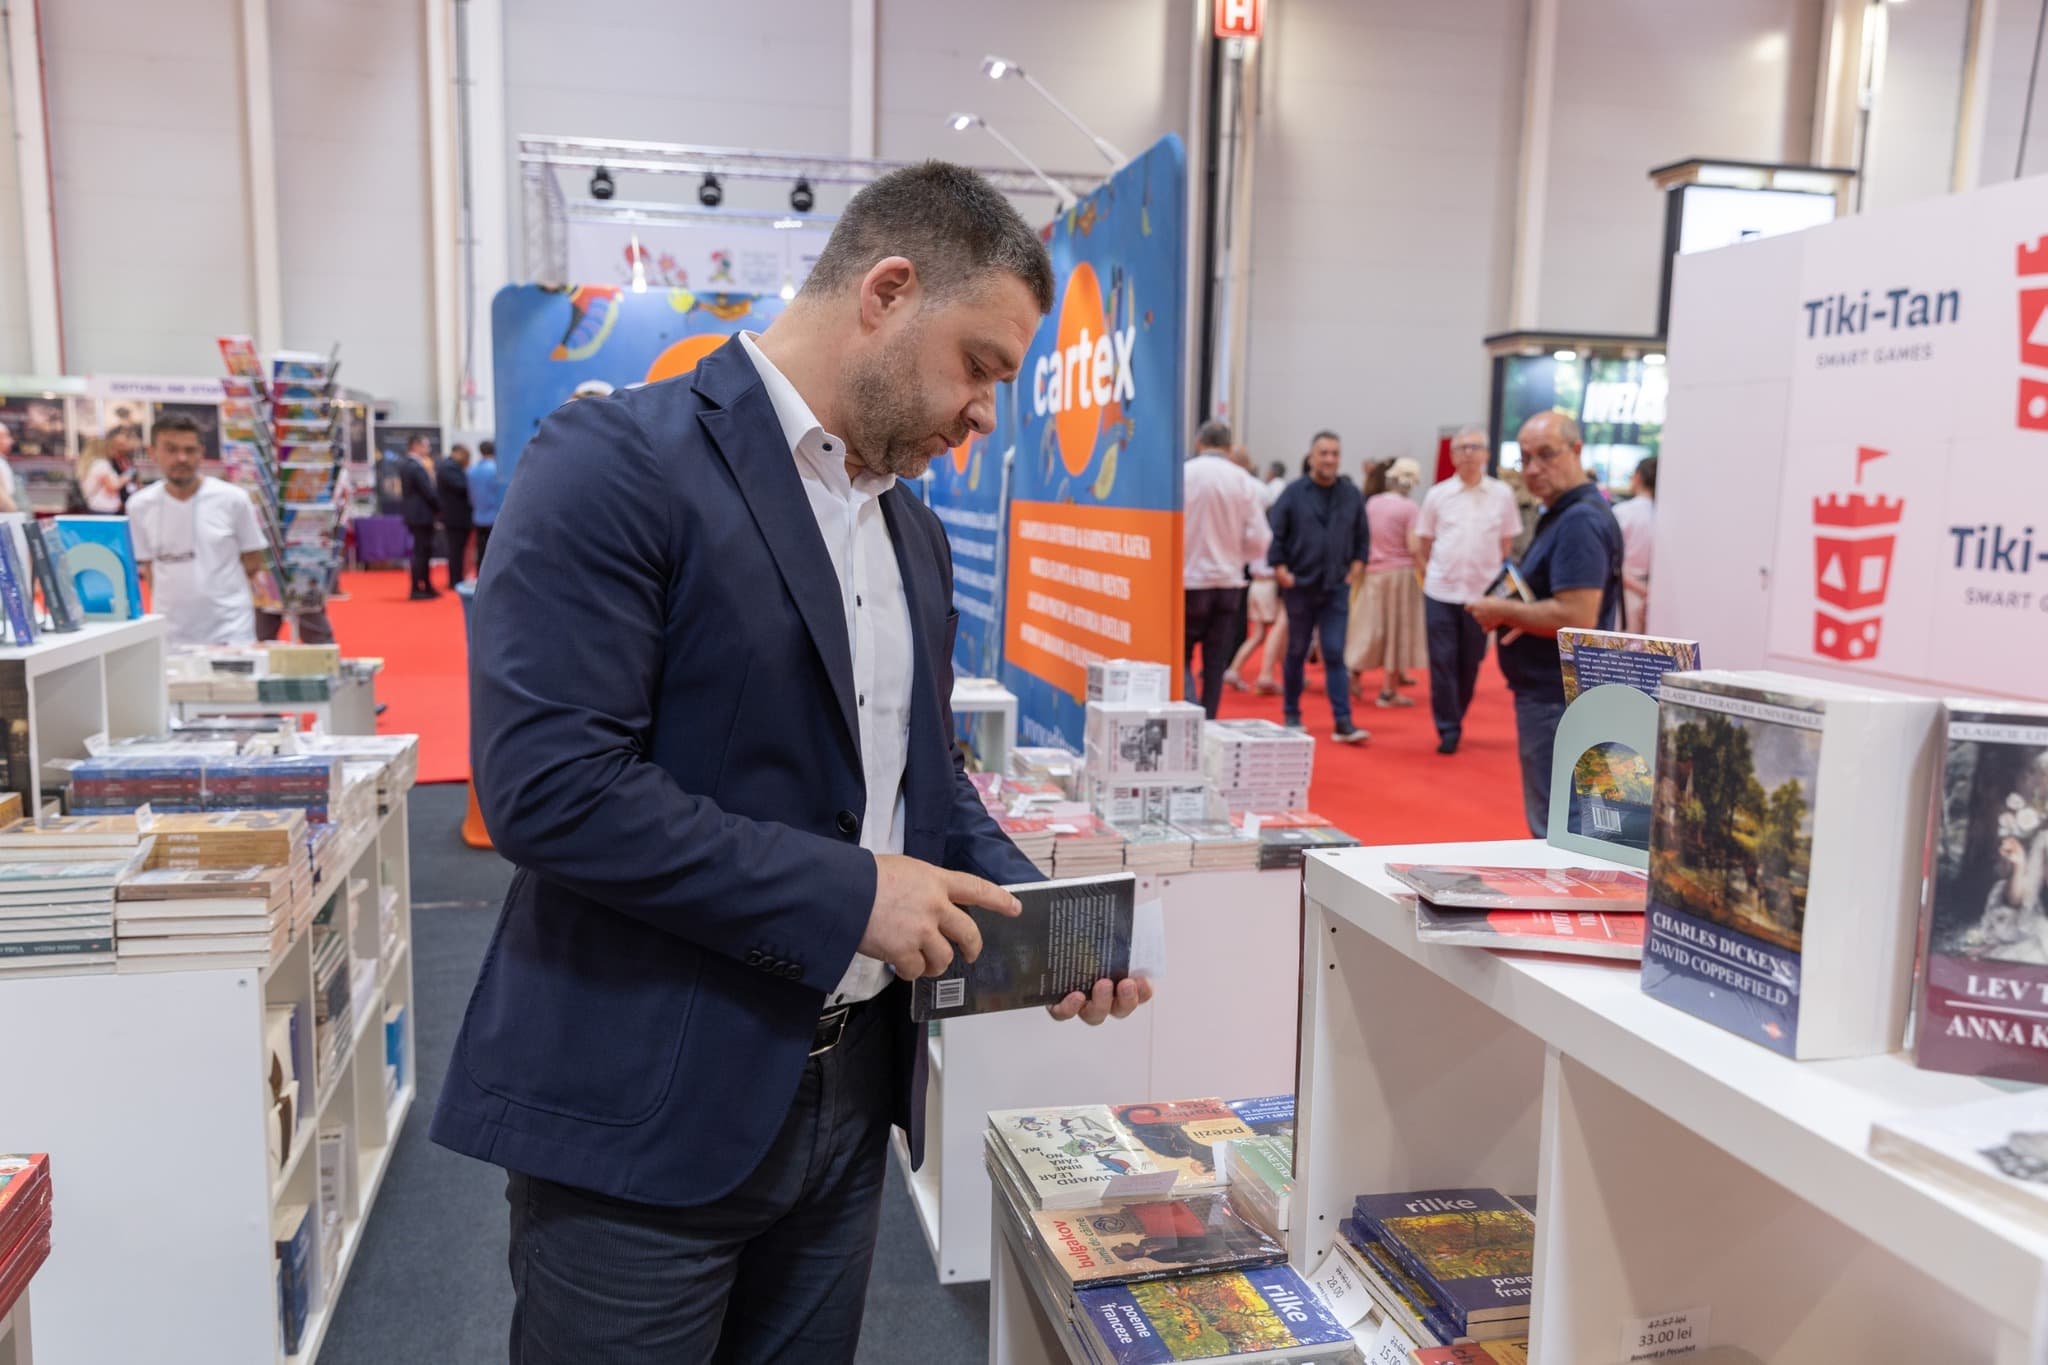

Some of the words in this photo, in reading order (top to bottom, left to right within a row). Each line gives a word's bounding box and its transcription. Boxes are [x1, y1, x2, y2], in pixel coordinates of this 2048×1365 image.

[1804, 287, 1961, 339] Tiki-Tan
[1816, 350, 1868, 369] SMART
[1873, 342, 1934, 364] GAMES
[1033, 325, 1136, 417] cartex
[1965, 587, 2032, 608] SMART
[1652, 911, 1717, 949] CHARLES
[1719, 937, 1793, 977] DICKENS
[1651, 938, 1690, 966] DAVID
[1691, 955, 1789, 1006] COPPERFIELD
[1967, 975, 2031, 1001] LEV
[1945, 1014, 2026, 1046] ANNA
[1193, 1125, 1245, 1139] poezii
[1038, 1172, 1074, 1182] LEAR
[1057, 1174, 1112, 1186] DWARD
[1405, 1198, 1478, 1213] rilke
[1053, 1220, 1096, 1269] bulgakov
[1326, 1275, 1345, 1299] 28.00
[1263, 1283, 1308, 1323] rilke
[1100, 1302, 1133, 1345] franceze
[1118, 1304, 1151, 1338] poeme
[1638, 1329, 1674, 1347] 33.00
[1677, 1326, 1693, 1340] lei
